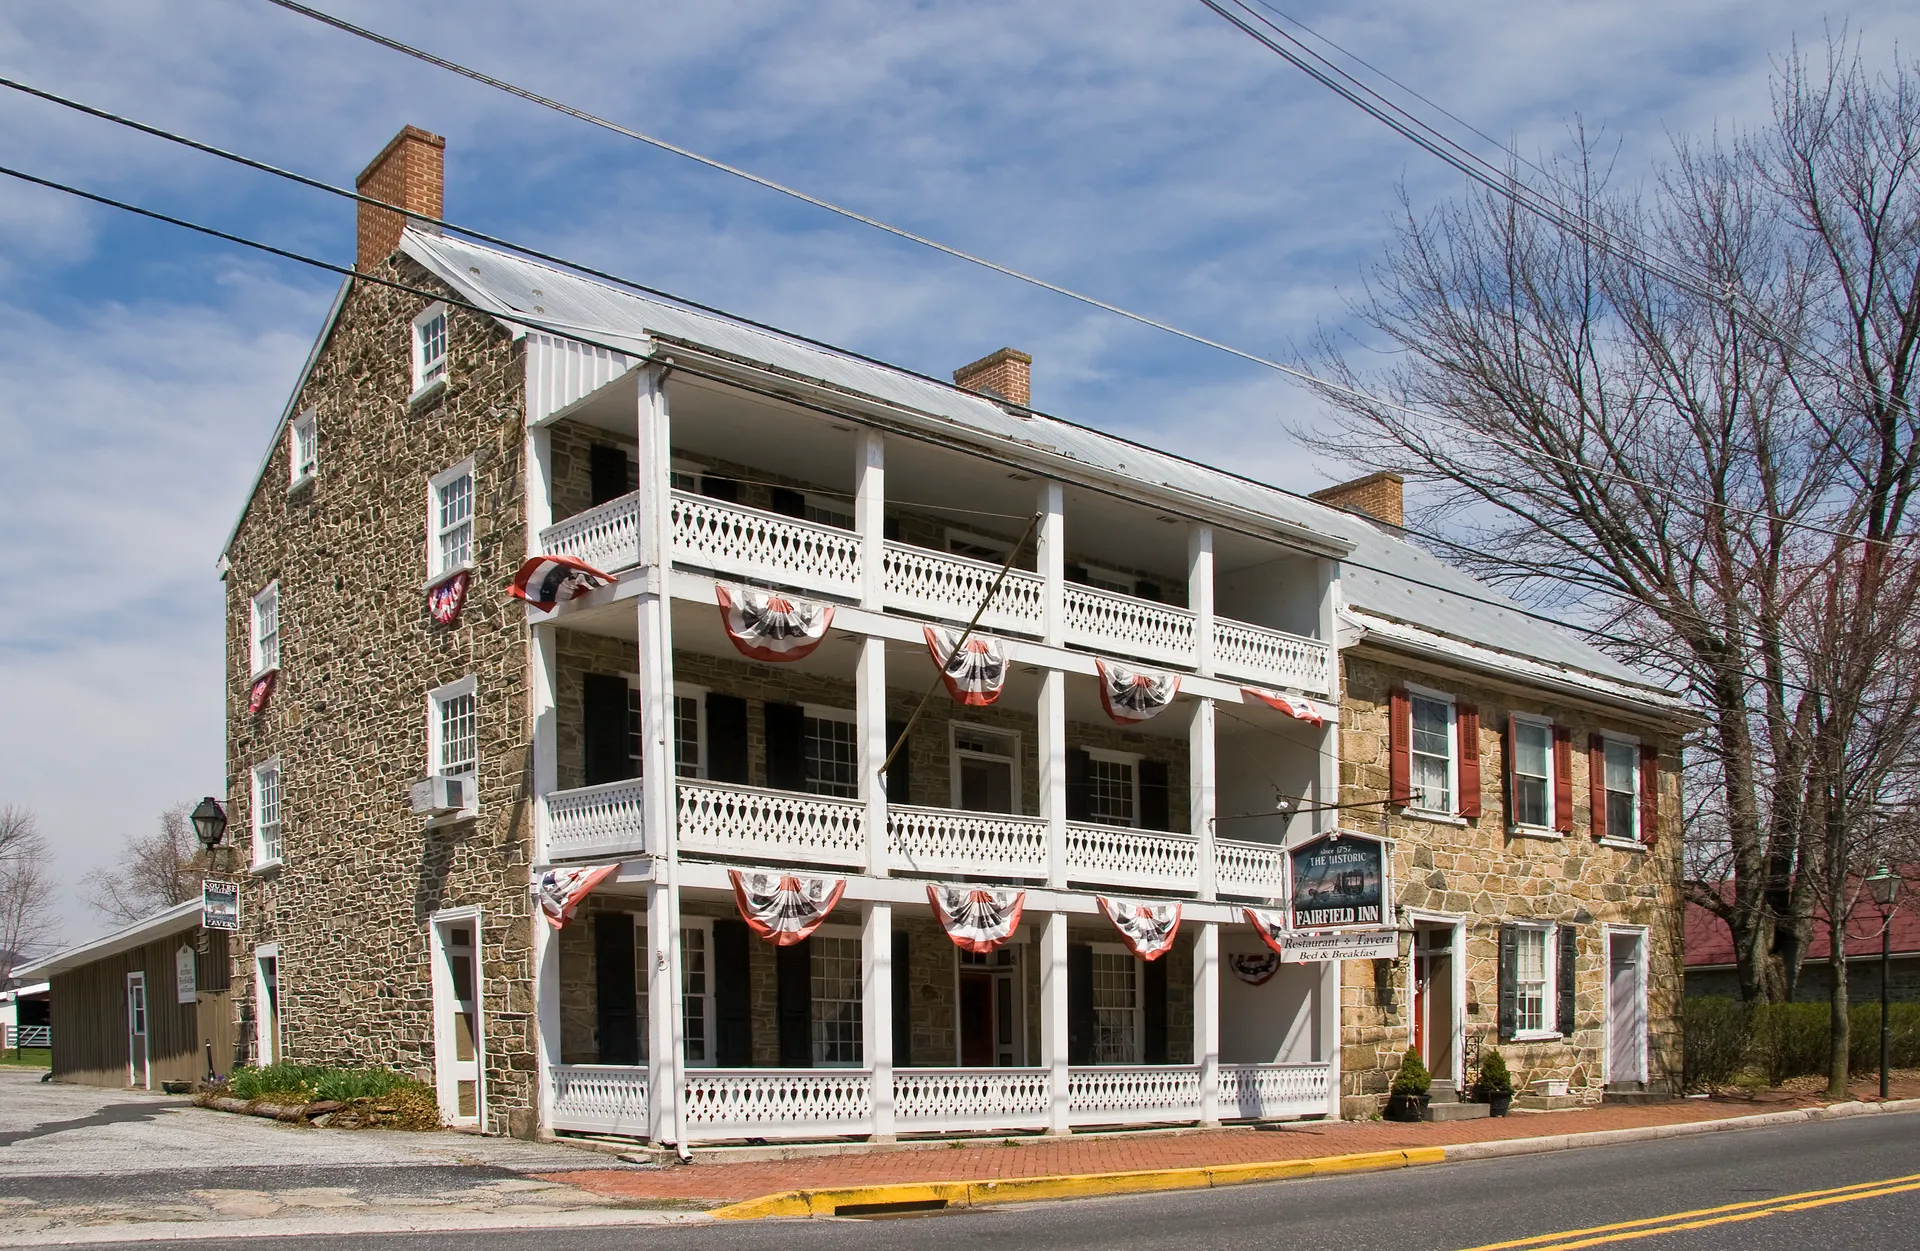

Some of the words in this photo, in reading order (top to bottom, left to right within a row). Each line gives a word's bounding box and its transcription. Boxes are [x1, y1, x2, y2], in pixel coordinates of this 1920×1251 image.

[1336, 845, 1352, 854] 1757
[1310, 857, 1326, 866] THE
[1329, 852, 1367, 864] HISTORIC
[205, 882, 237, 892] SQUIRE
[1296, 908, 1355, 925] FAIRFIELD
[1358, 905, 1379, 921] INN
[207, 920, 237, 928] TAVERN
[1284, 938, 1338, 949] Restaurant
[1356, 933, 1394, 945] Tavern
[1299, 951, 1318, 960] Bed
[1320, 950, 1328, 958] &
[1331, 948, 1377, 958] Breakfast
